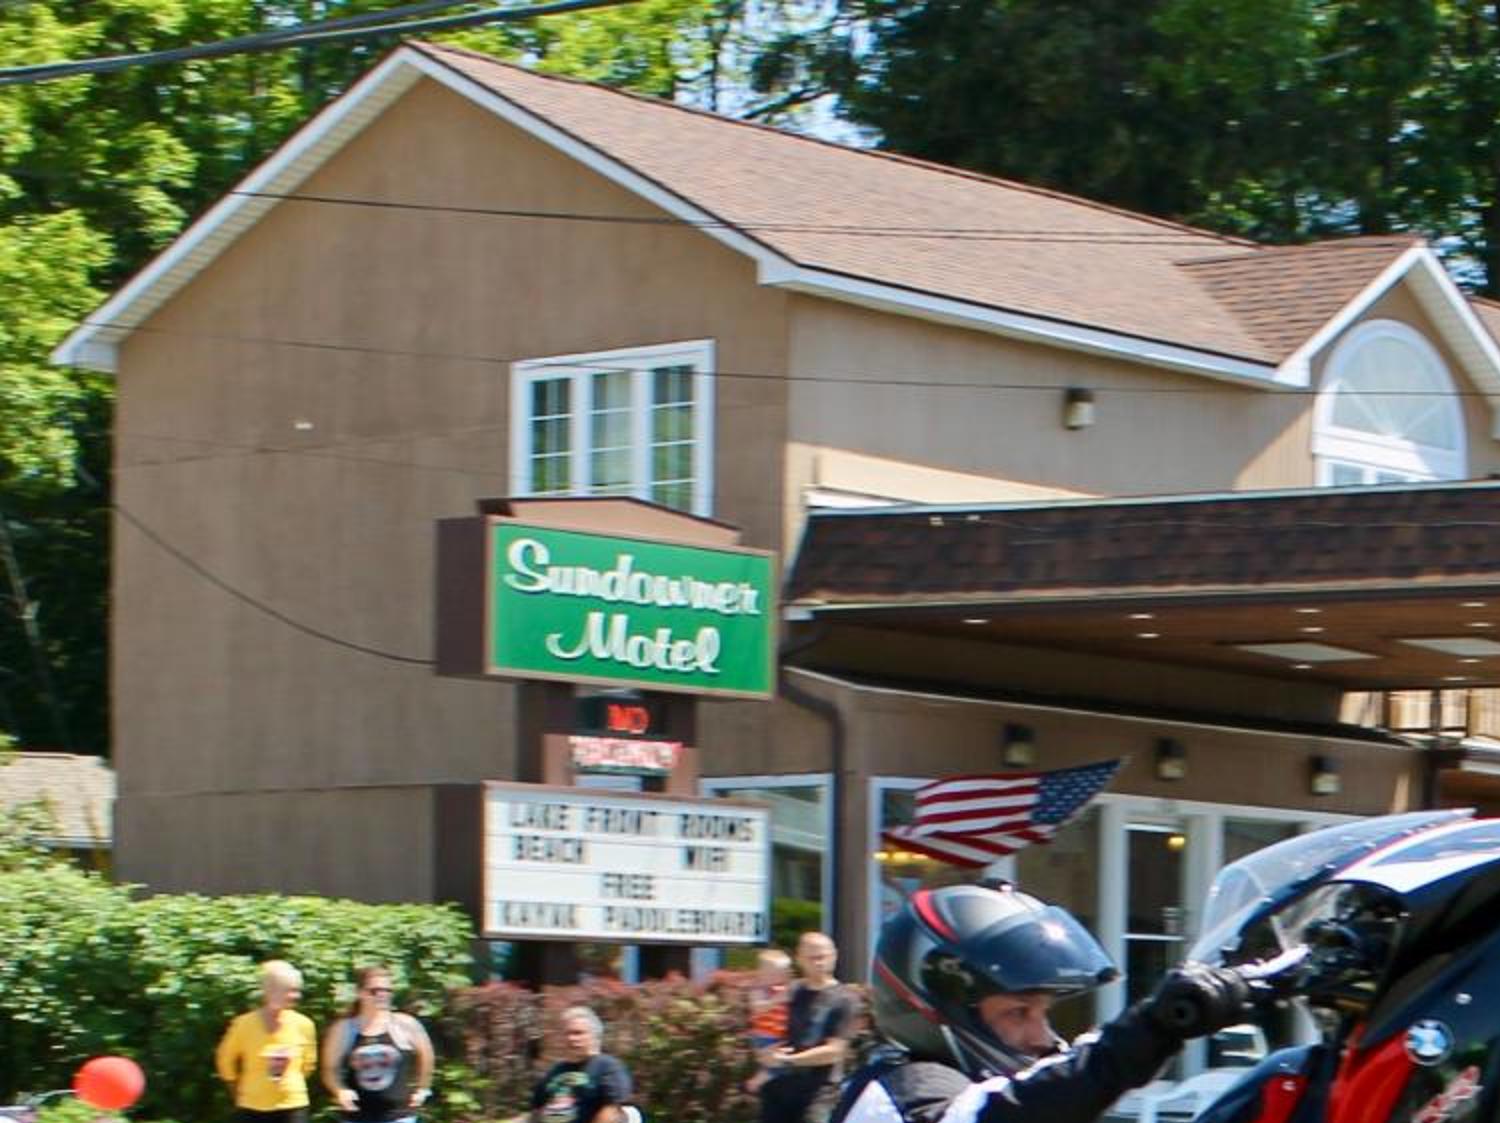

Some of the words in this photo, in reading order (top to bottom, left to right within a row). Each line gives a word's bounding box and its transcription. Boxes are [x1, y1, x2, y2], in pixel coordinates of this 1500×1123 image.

[503, 539, 762, 615] Sundowner
[546, 611, 721, 674] Motel
[510, 802, 569, 831] LAKE
[584, 807, 659, 835] FRONT
[680, 812, 754, 842] ROOMS
[514, 835, 583, 864] BEACH
[602, 873, 656, 901] FREE
